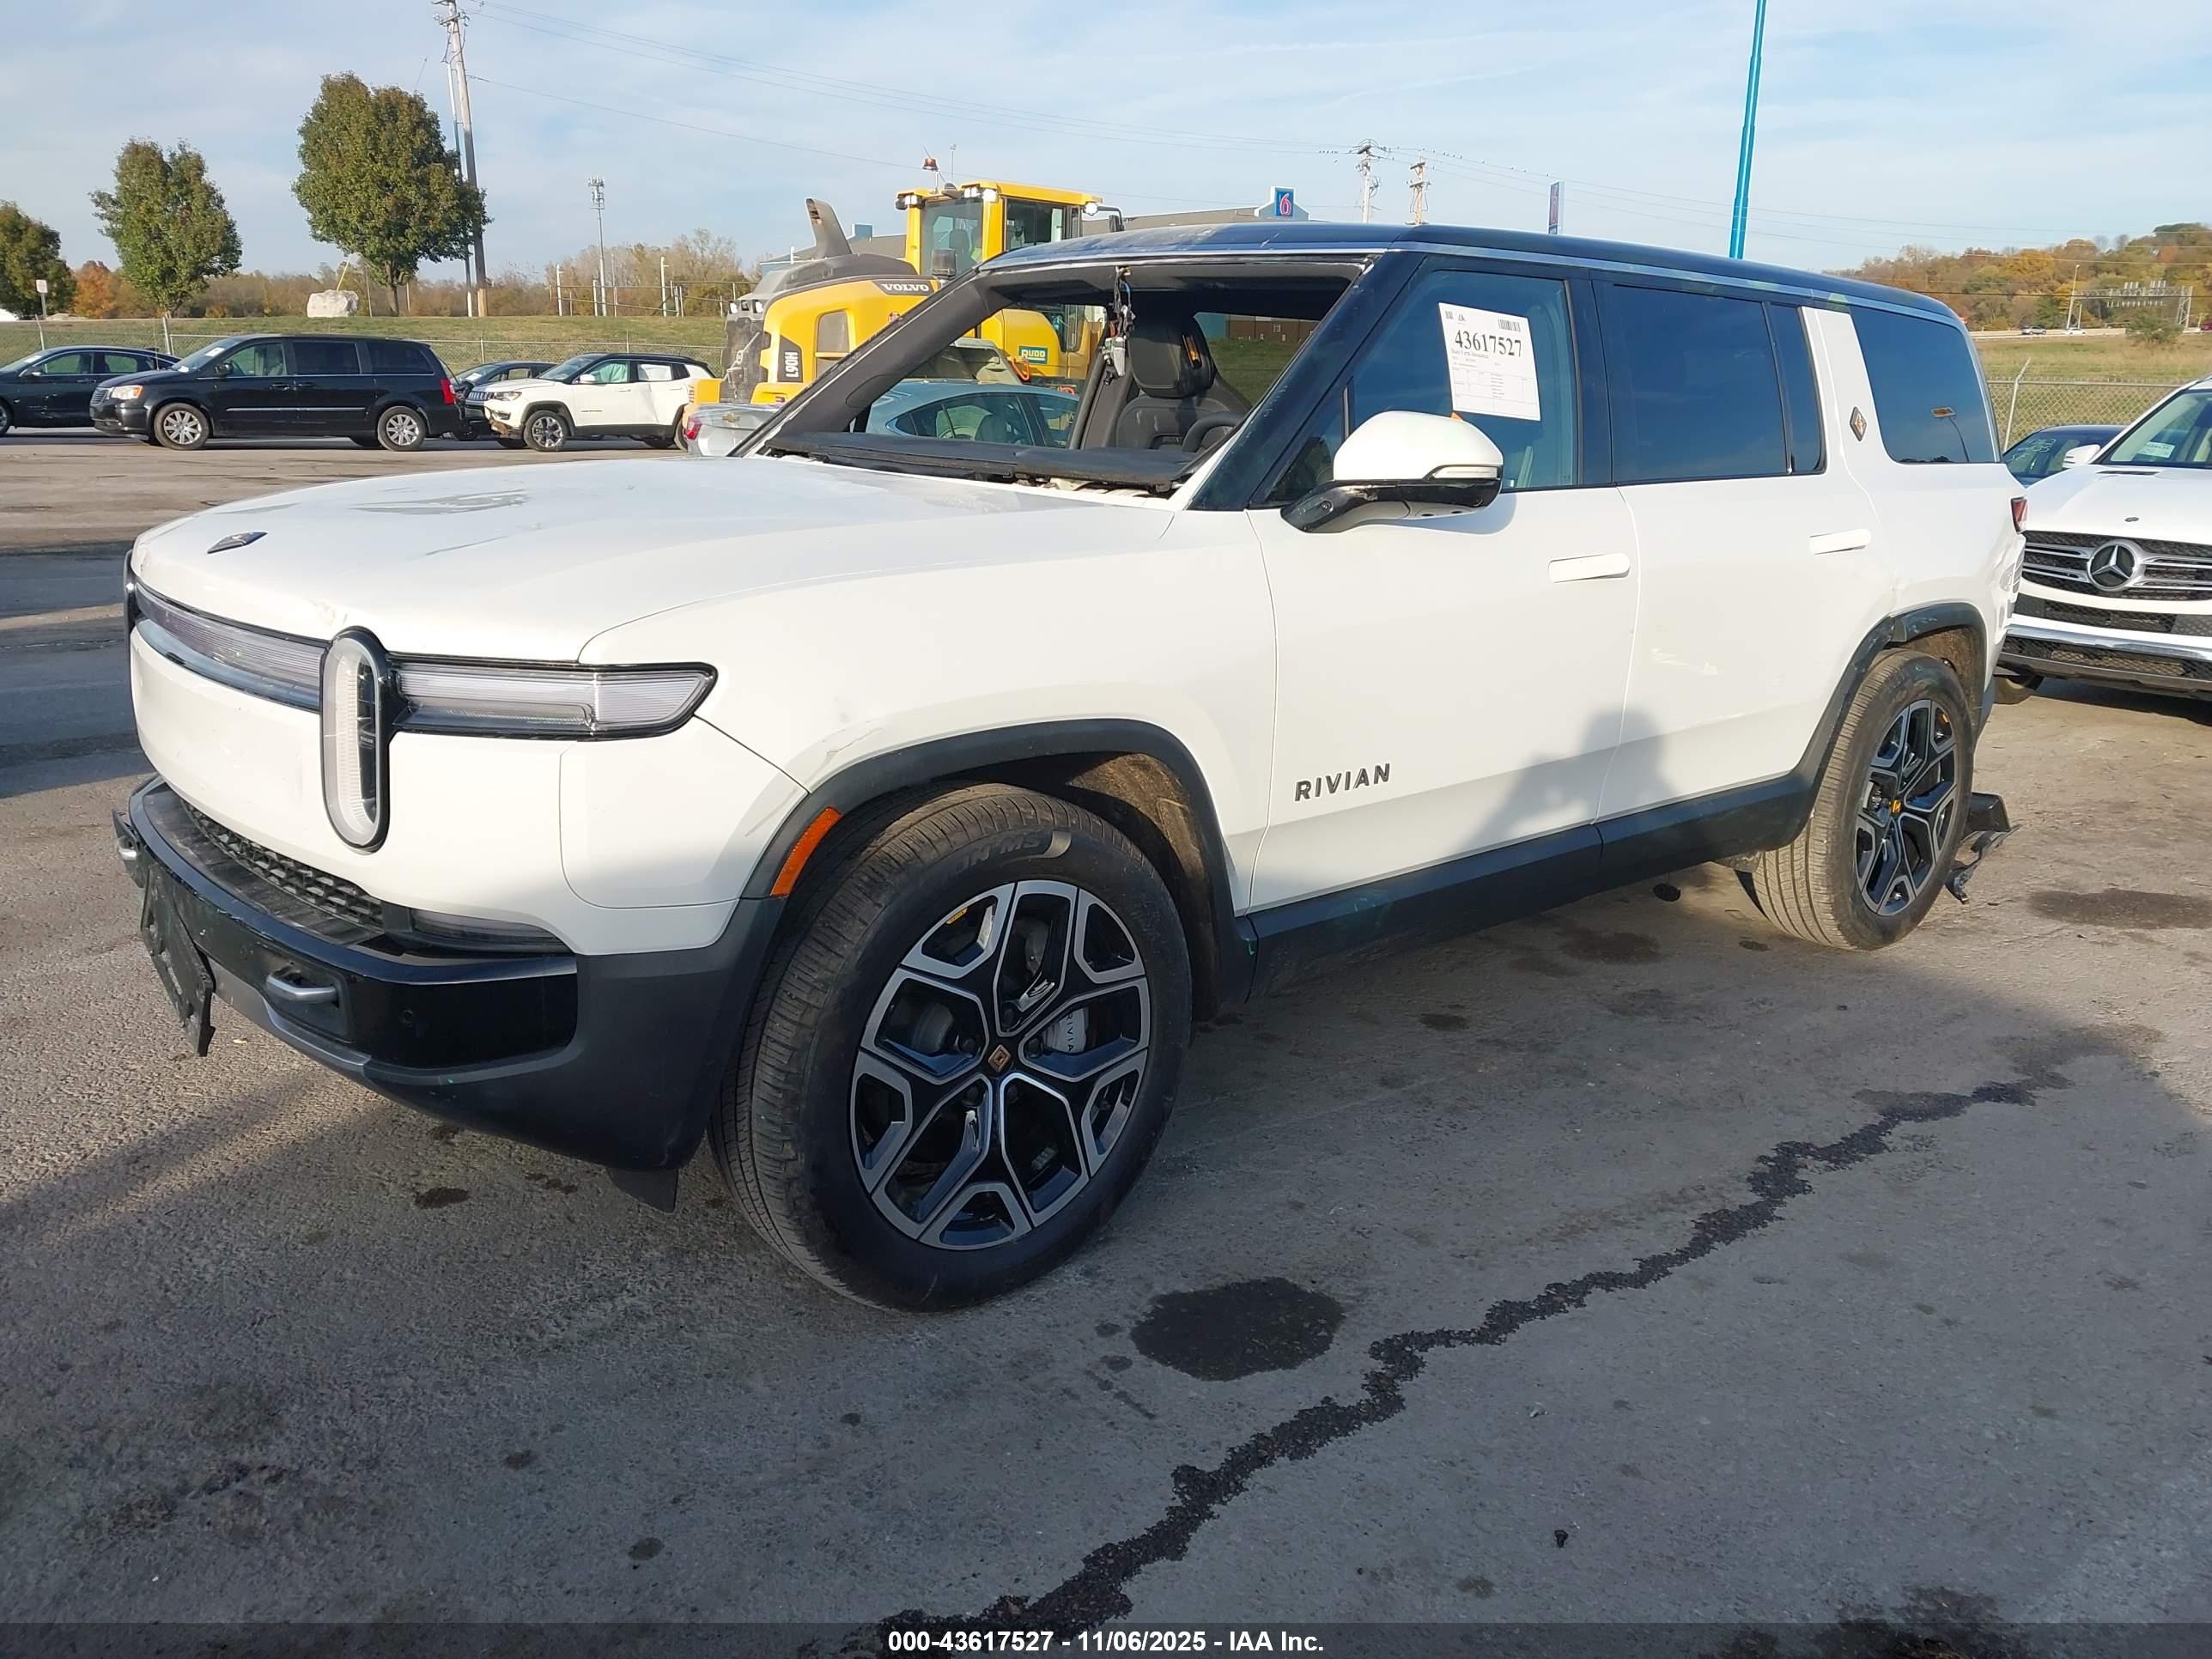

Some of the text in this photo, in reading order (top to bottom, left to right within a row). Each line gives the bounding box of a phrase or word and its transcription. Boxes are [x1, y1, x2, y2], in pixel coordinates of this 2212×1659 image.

[1279, 192, 1291, 216] 6
[880, 283, 929, 292] VOLVO
[1455, 329, 1522, 357] 43617527
[784, 351, 799, 378] L90H
[1294, 763, 1390, 801] RIVIAN
